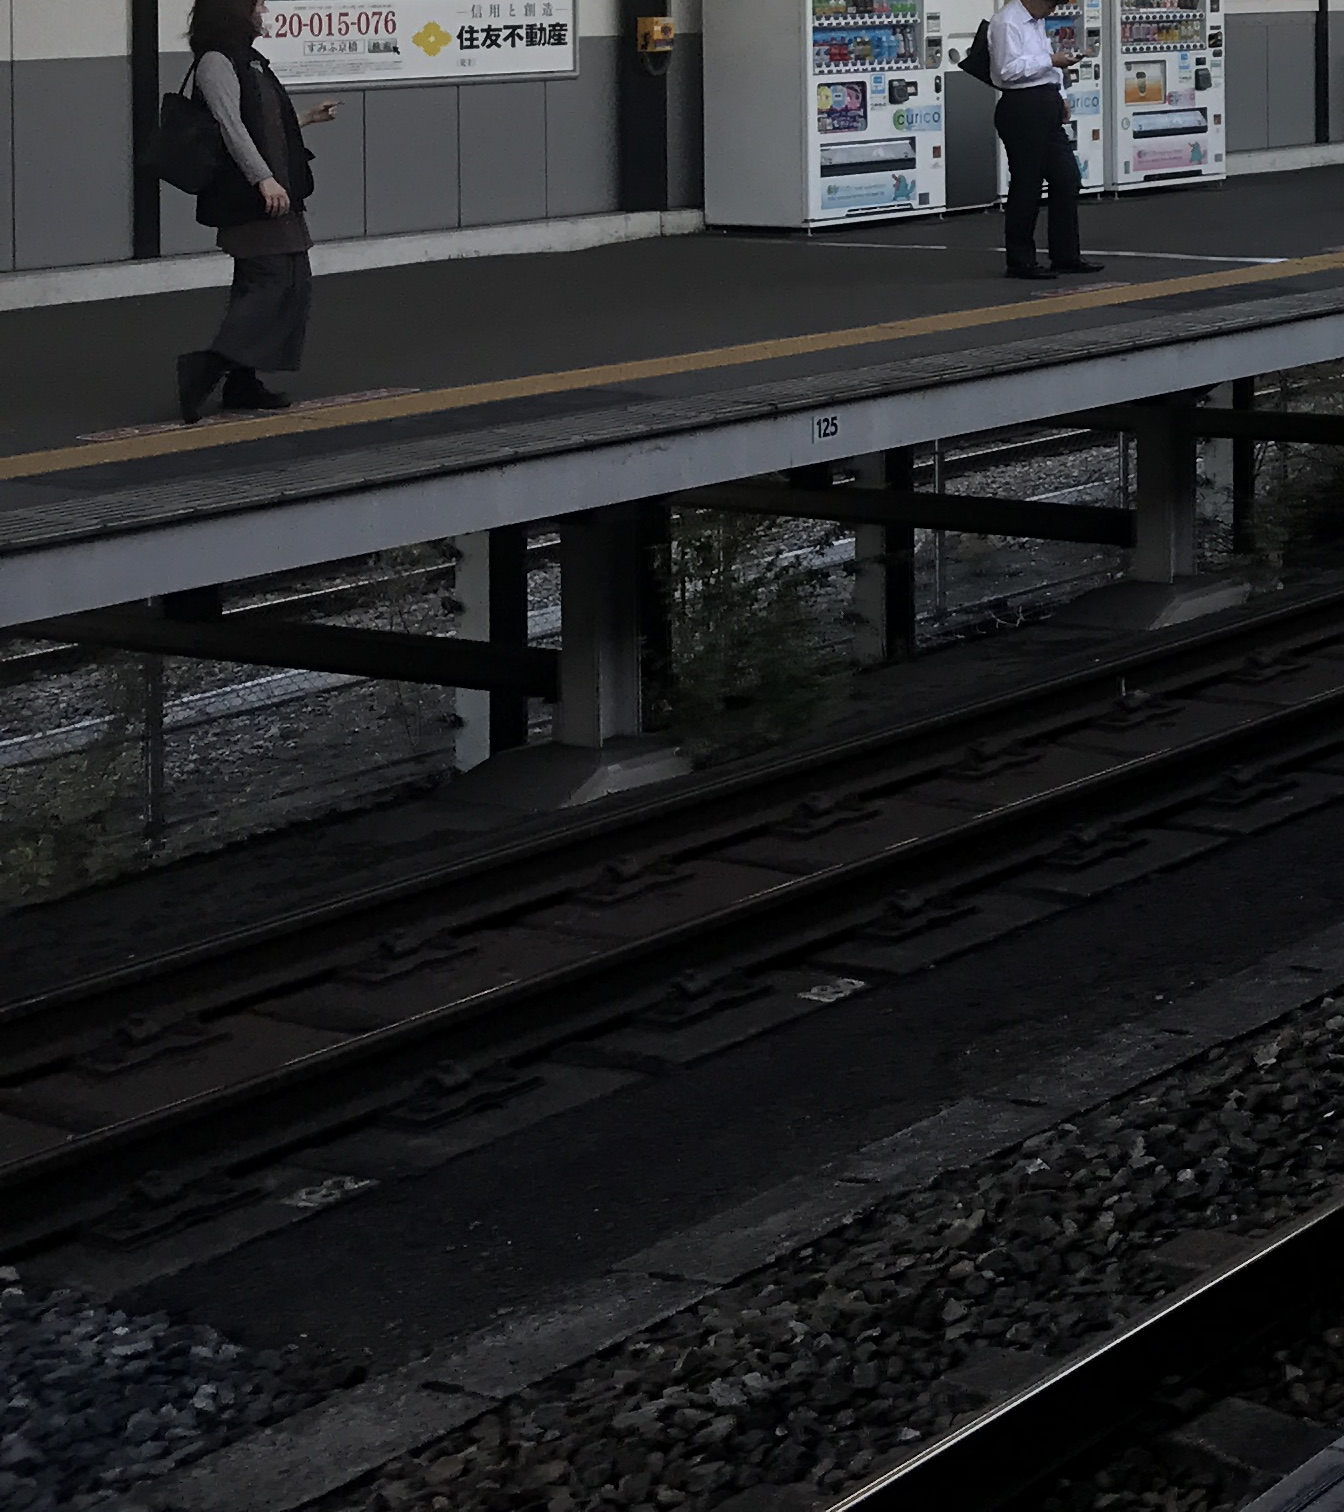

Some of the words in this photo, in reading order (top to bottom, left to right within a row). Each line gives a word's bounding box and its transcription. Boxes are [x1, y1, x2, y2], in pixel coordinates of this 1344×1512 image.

[456, 22, 569, 50] 住友不動産
[1069, 93, 1099, 108] urico
[897, 111, 941, 126] curico
[816, 415, 839, 439] 125
